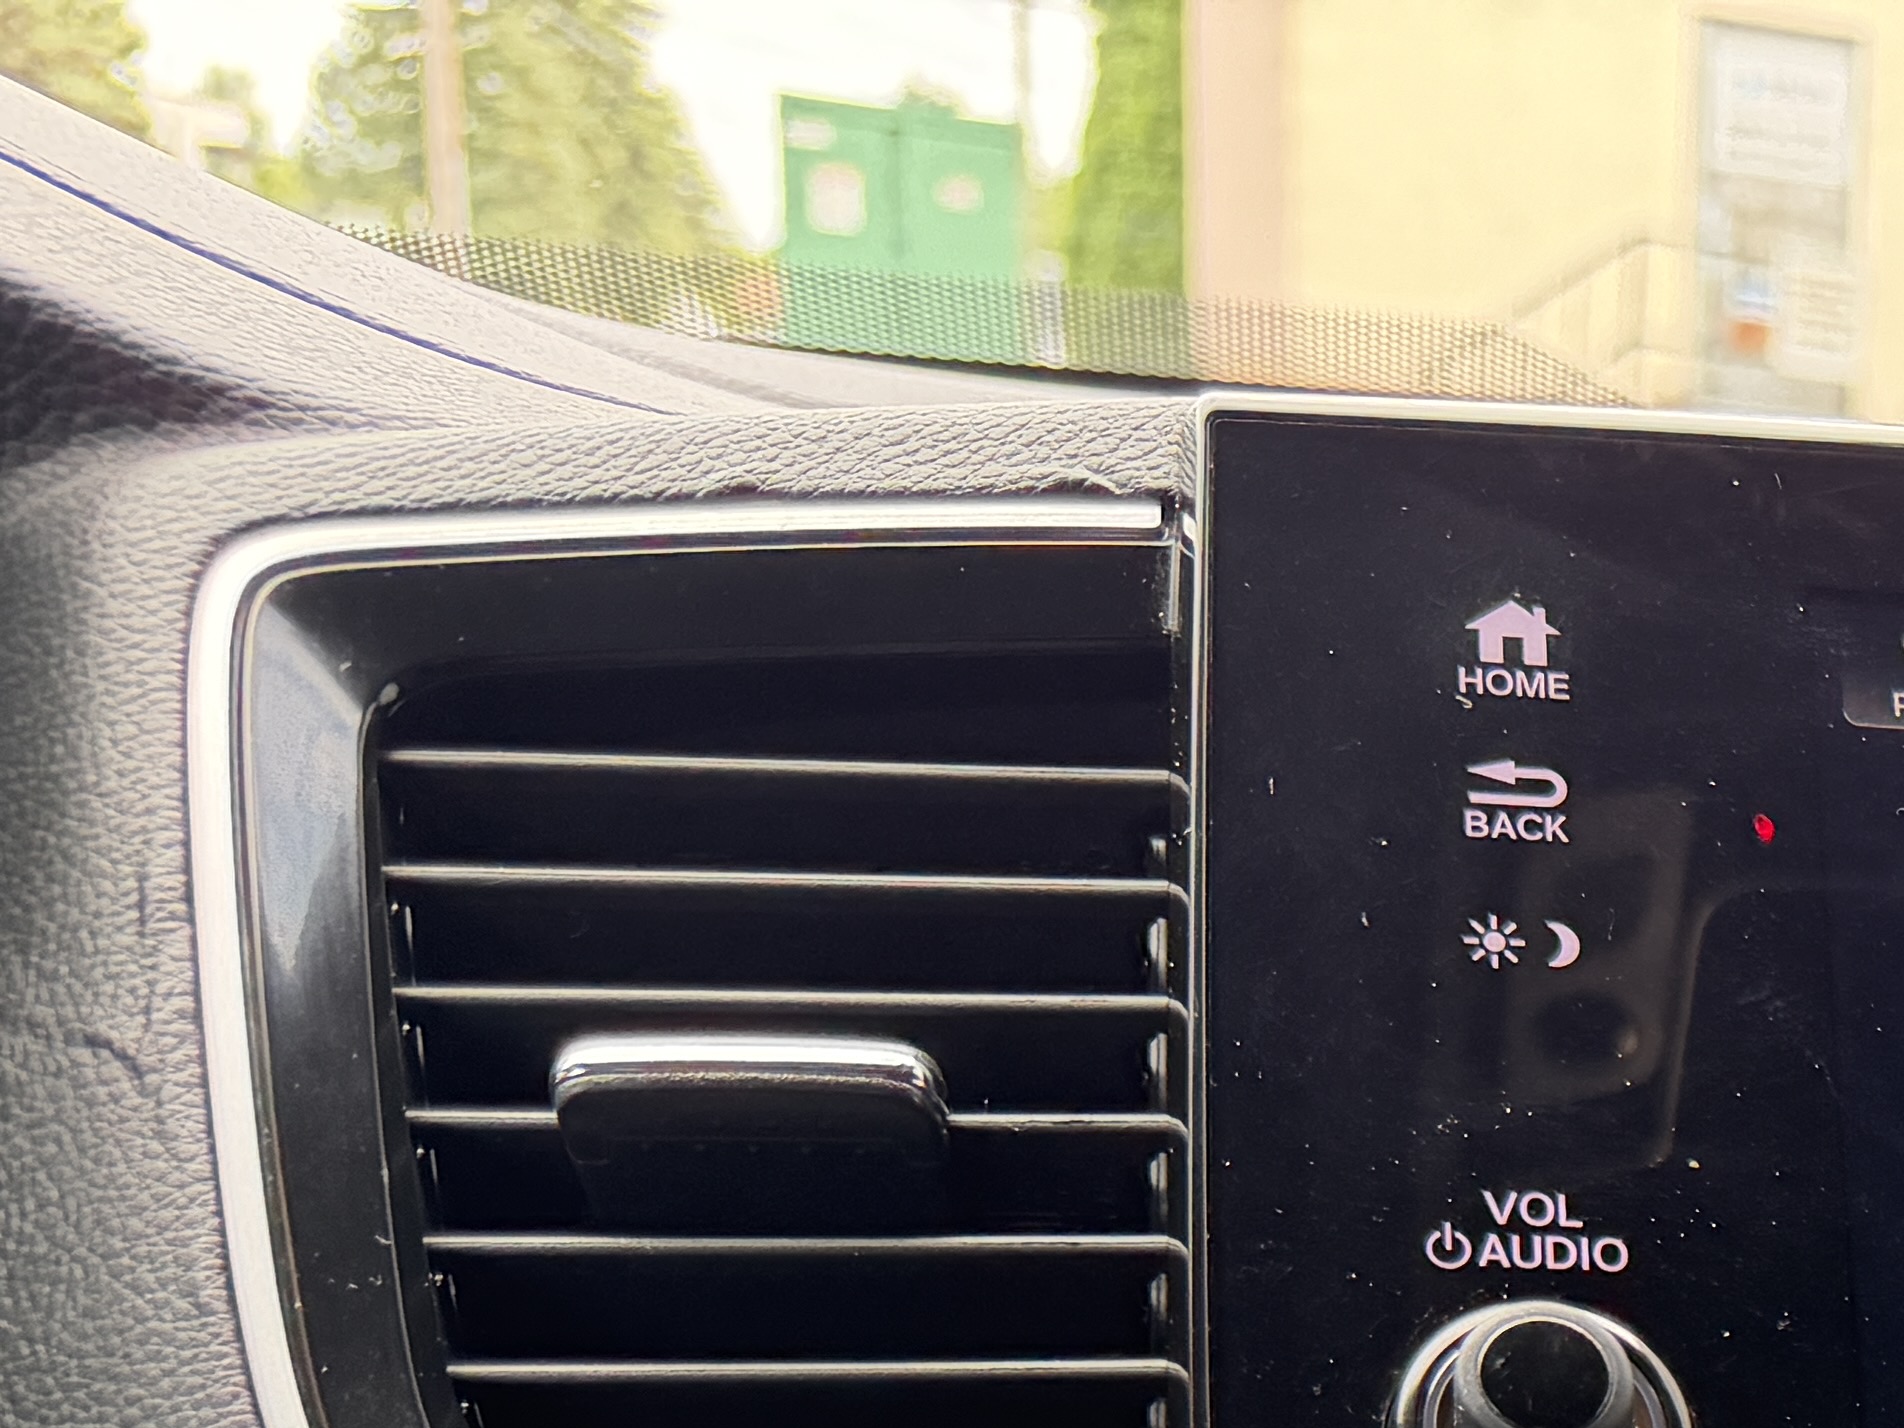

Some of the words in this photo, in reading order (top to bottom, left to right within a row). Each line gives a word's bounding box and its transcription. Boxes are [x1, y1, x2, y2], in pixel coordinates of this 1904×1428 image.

[1457, 665, 1571, 702] HOME
[1463, 808, 1571, 844] BACK
[1483, 1189, 1584, 1228] VOL
[1478, 1233, 1630, 1273] AUDIO
